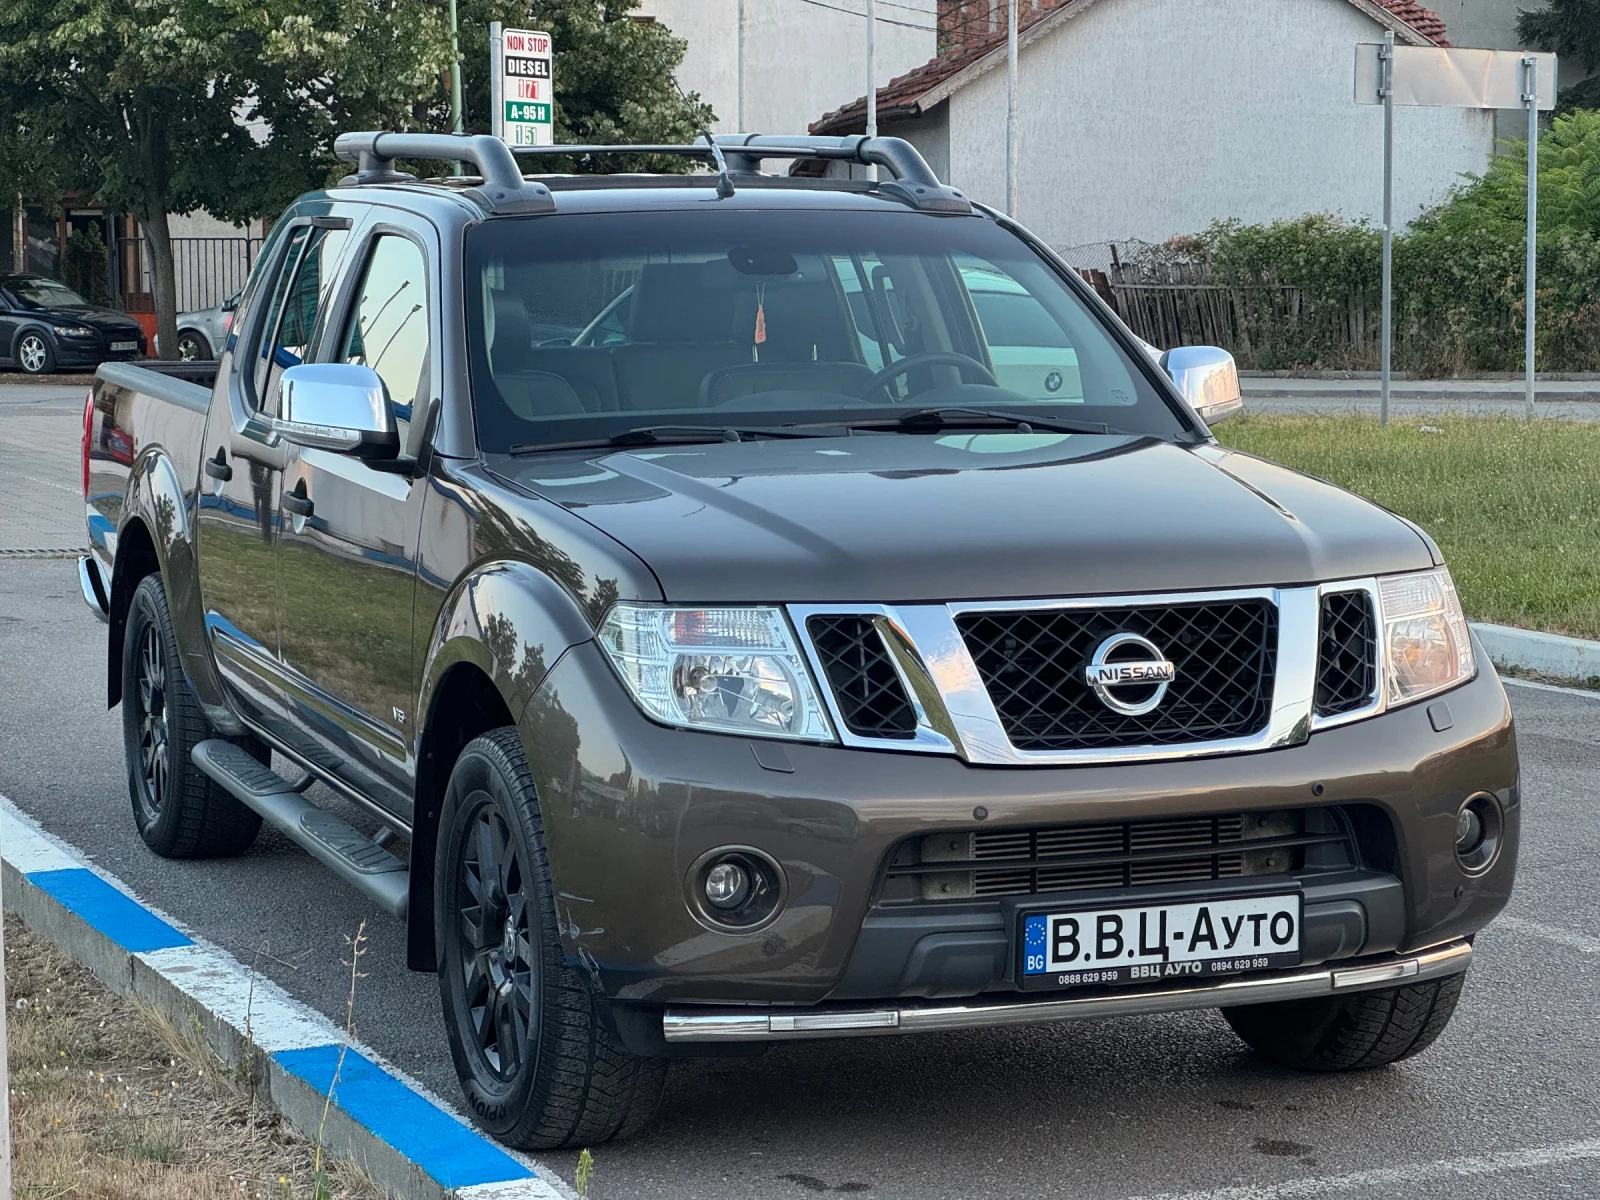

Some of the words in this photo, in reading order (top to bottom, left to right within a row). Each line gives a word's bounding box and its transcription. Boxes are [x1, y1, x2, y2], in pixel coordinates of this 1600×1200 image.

[507, 36, 525, 51] NON
[528, 38, 548, 53] STOP
[508, 59, 548, 76] DIESEL
[1099, 666, 1168, 681] NISSAN
[1027, 955, 1044, 970] BG
[1130, 964, 1160, 979] ВВЦ
[1164, 961, 1202, 976] АУТО
[1211, 961, 1232, 971] 0894
[1234, 959, 1251, 970] 629
[1252, 958, 1268, 968] 959
[1058, 974, 1081, 985] 0888
[1082, 972, 1099, 983] 629
[1101, 971, 1118, 981] 959
